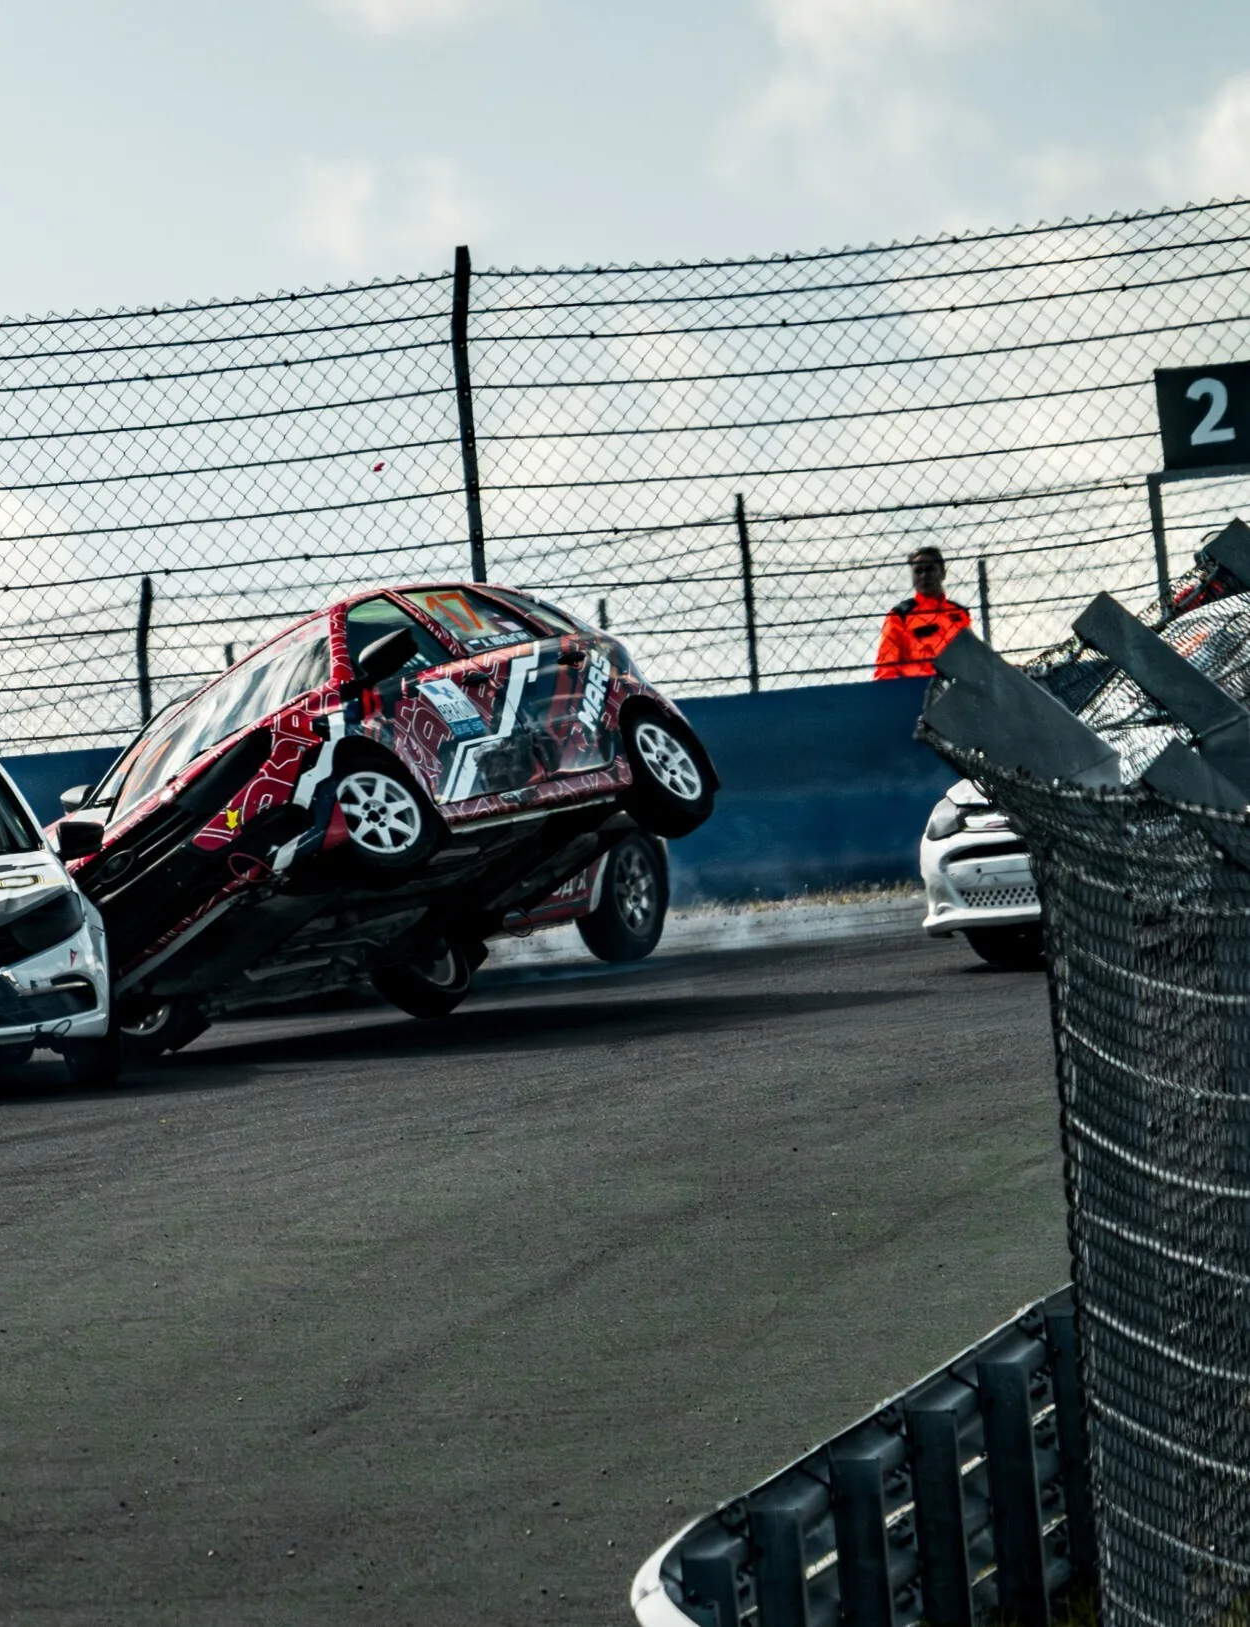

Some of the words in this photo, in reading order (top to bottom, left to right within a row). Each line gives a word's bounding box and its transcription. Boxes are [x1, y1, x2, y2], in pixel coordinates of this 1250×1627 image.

[1186, 377, 1236, 446] 2
[425, 591, 484, 633] 17
[577, 649, 611, 733] MARS
